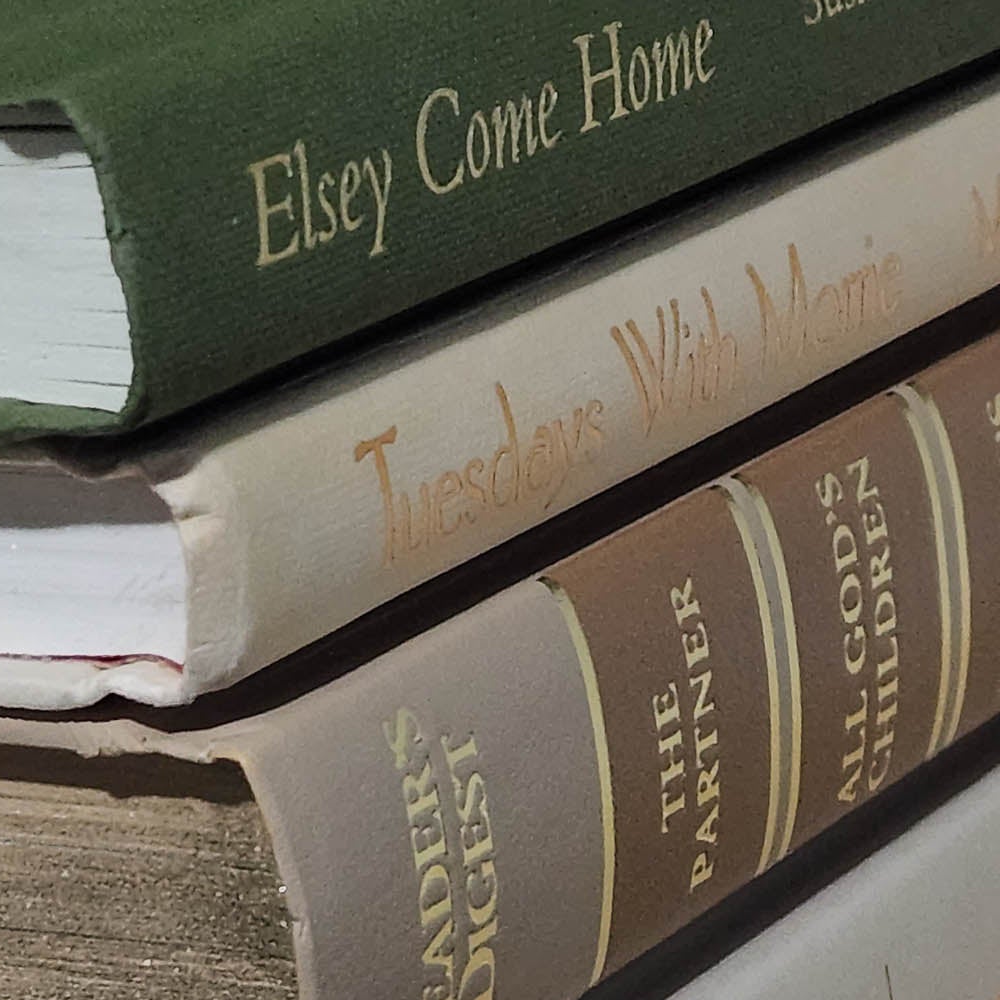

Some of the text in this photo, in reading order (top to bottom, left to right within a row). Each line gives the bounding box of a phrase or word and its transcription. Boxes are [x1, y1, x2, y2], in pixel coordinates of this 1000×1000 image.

[249, 19, 716, 267] Elsey Come Home
[355, 382, 604, 566] Tuesdays
[610, 286, 738, 437] With
[652, 682, 686, 834] THE
[670, 576, 721, 893] PARTNER
[815, 472, 869, 804] ALL GOD'S
[846, 455, 900, 793] CHILDREN
